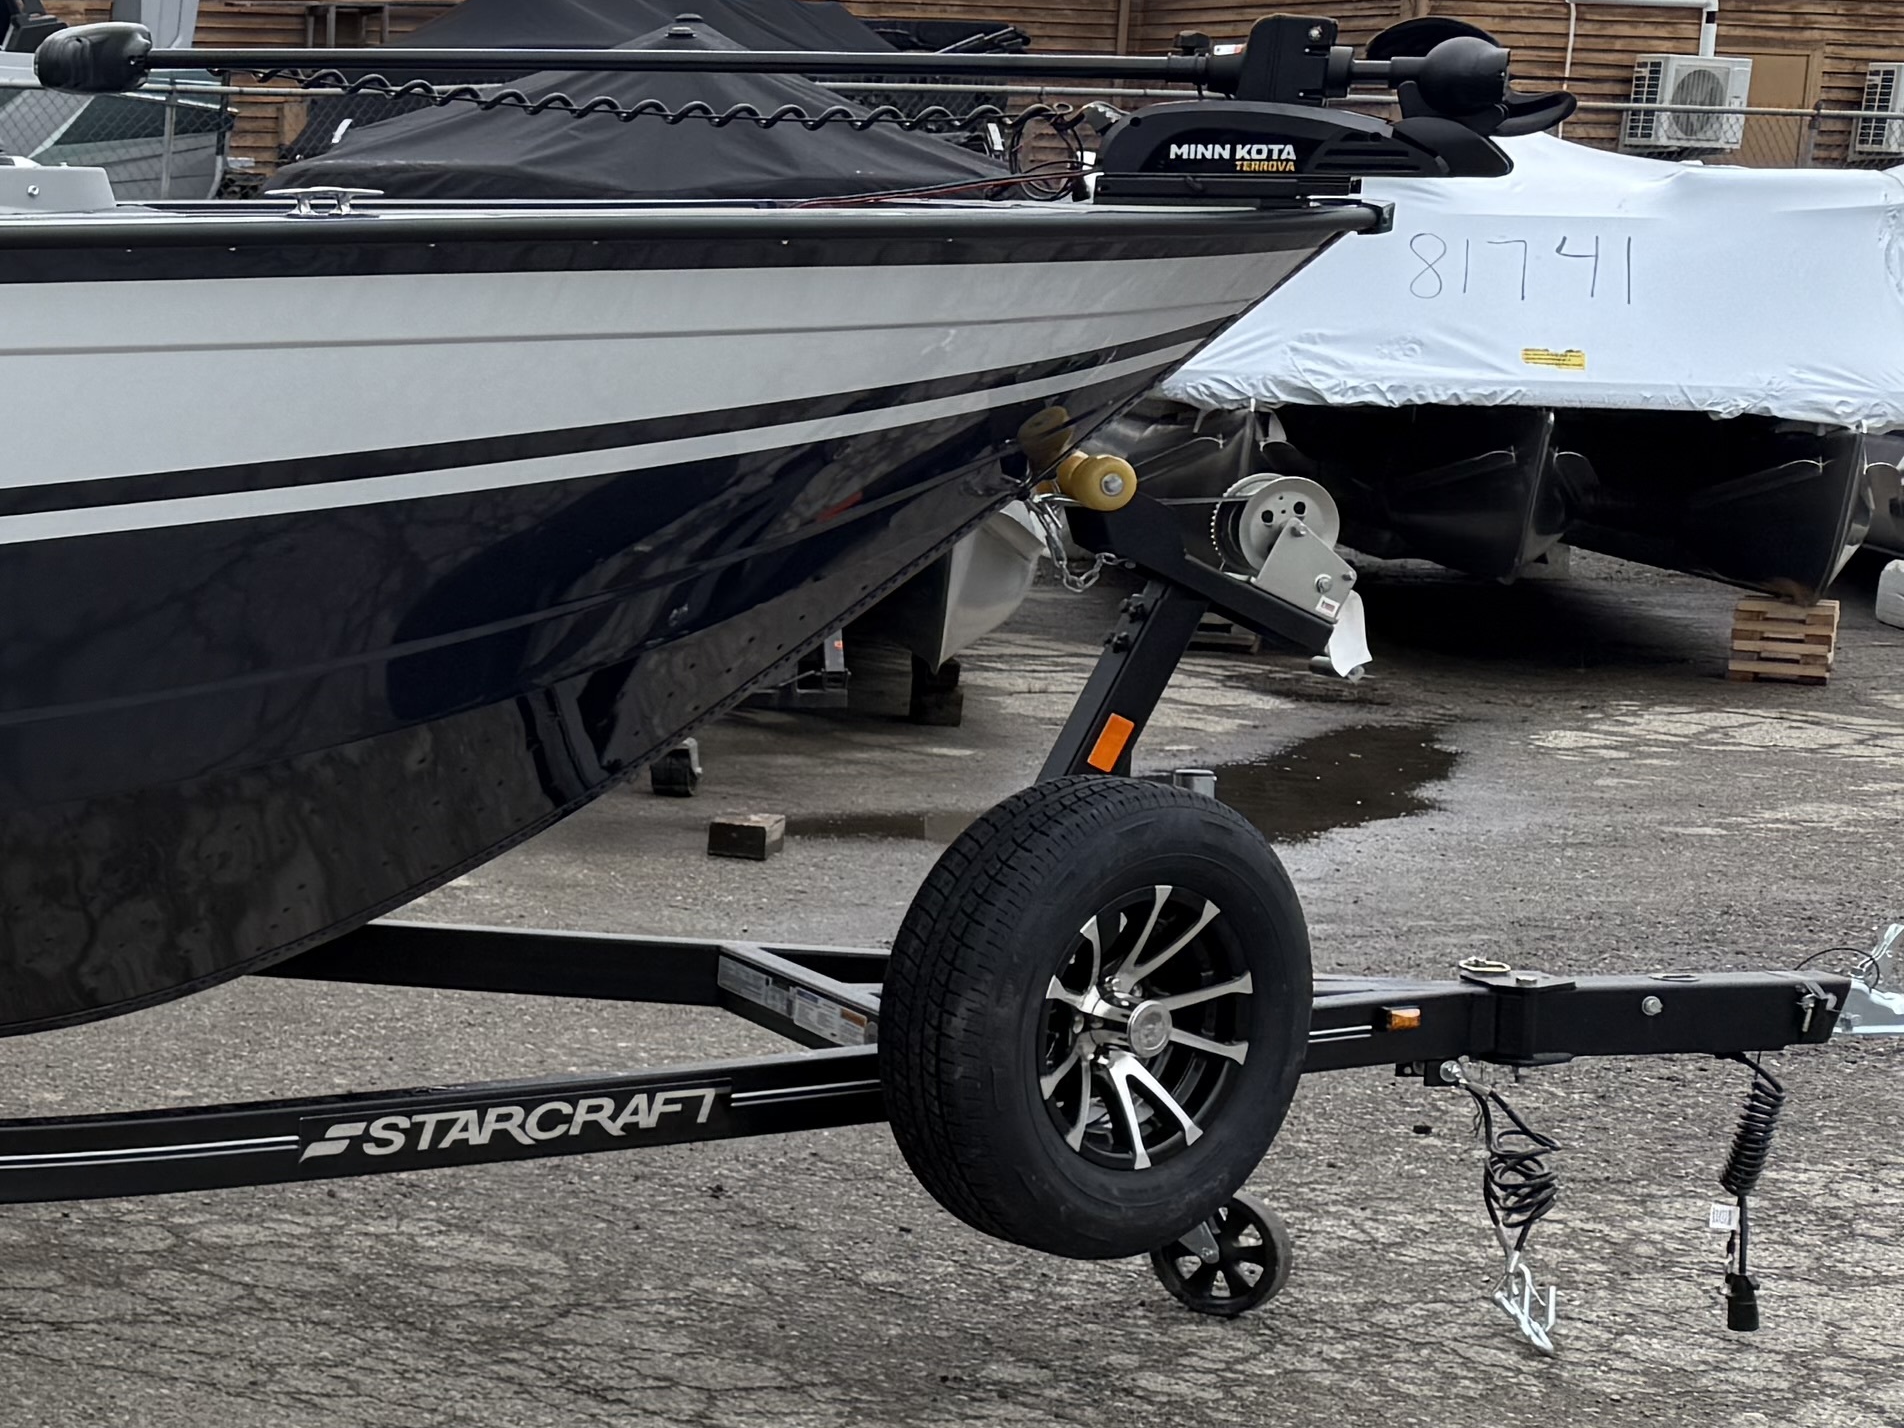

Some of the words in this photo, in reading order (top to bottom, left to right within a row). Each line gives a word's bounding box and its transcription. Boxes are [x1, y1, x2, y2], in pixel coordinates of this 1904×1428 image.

[1169, 143, 1231, 160] MINN
[1235, 143, 1297, 160] KOTA
[1235, 160, 1296, 172] TERROVA
[1409, 232, 1632, 305] 81741
[361, 1088, 717, 1156] STARCRAFT
